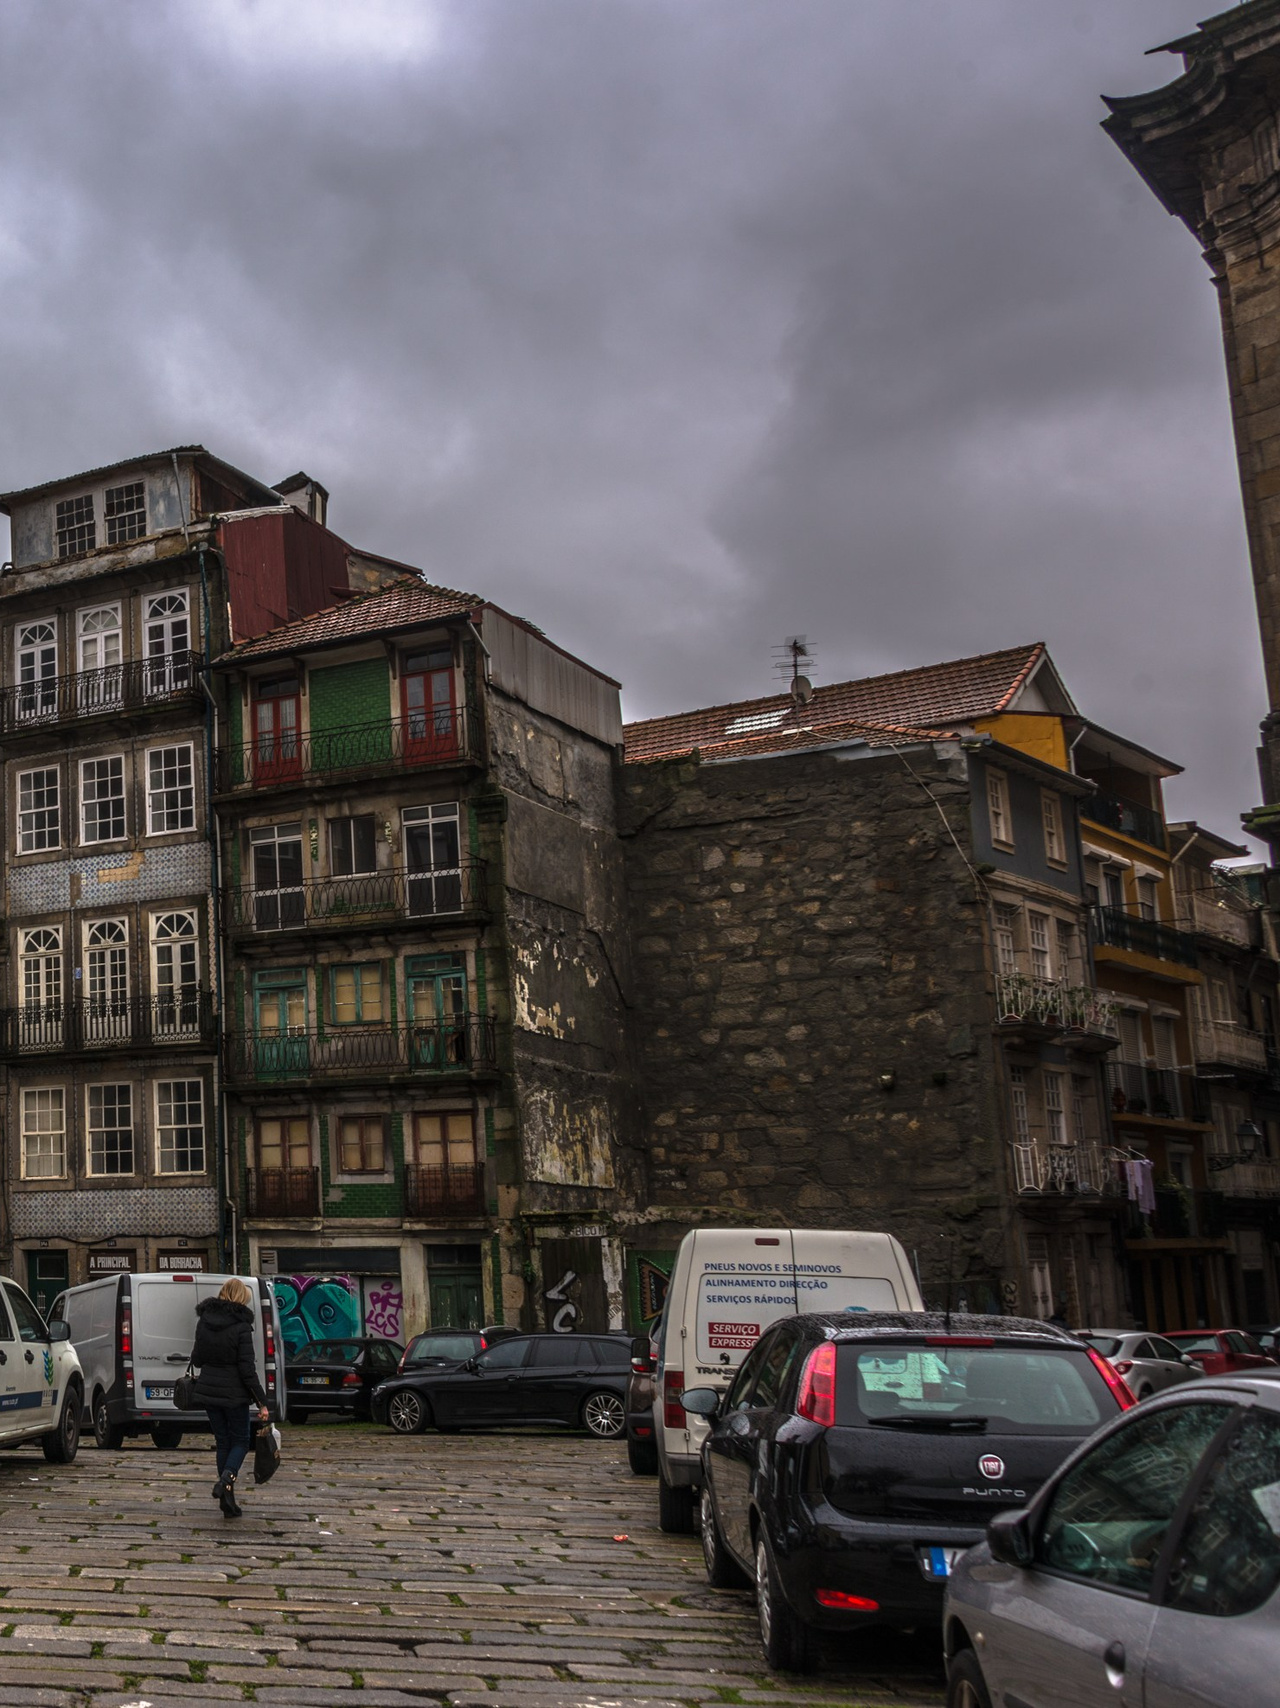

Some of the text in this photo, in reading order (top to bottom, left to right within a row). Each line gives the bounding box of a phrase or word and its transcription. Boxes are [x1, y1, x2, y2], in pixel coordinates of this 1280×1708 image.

[89, 1256, 131, 1269] A PRINCIPAL
[159, 1256, 203, 1269] DA BORRACHA
[704, 1262, 736, 1271] PNEUS
[738, 1263, 772, 1272] NOVOS
[782, 1264, 842, 1273] SEMINOVOS
[705, 1279, 828, 1290] ALINHAMENTO DIRECÇÃO
[706, 1294, 797, 1305] SERVIÇOS RÁPIDOS
[712, 1323, 757, 1335] SERVIÇO
[983, 1461, 999, 1473] FIAT
[962, 1487, 1027, 1498] PUNTO
